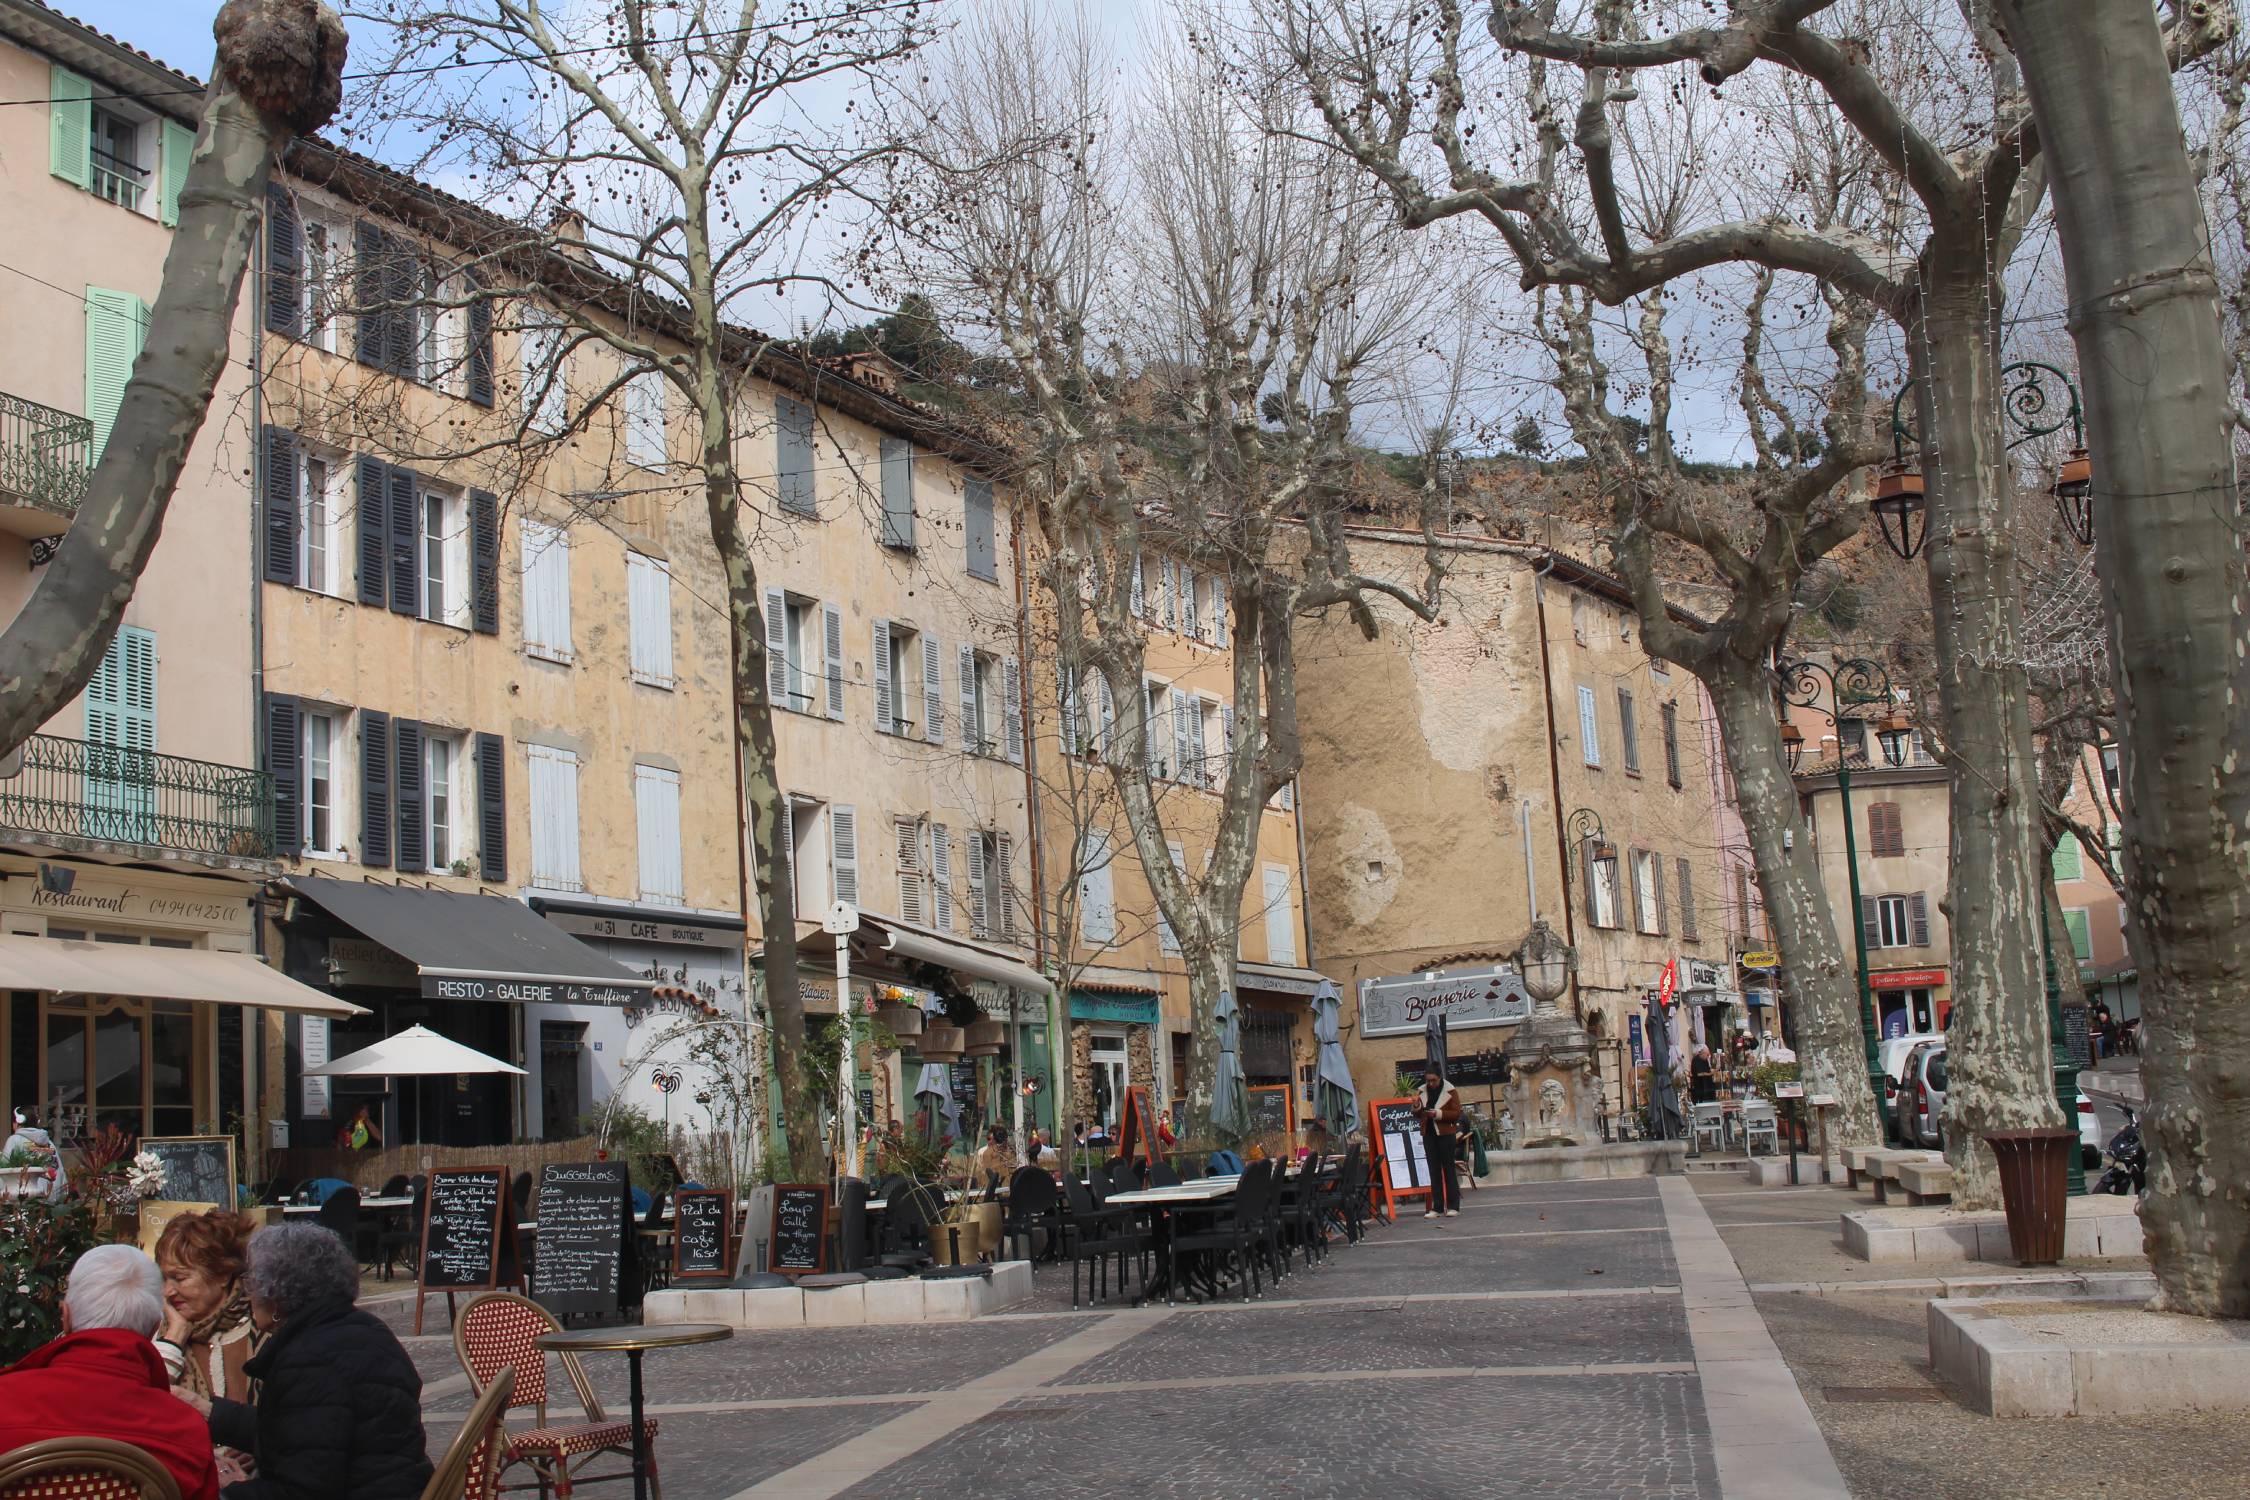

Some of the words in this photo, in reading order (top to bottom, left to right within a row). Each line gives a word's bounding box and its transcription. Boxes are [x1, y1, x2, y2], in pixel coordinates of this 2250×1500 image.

[32, 881, 140, 913] Restaurant
[605, 921, 616, 936] 31
[631, 923, 658, 940] CAFÉ
[672, 929, 705, 942] BOUTIQUE
[1662, 968, 1673, 996] TABAC
[1693, 967, 1717, 986] GALERIE
[438, 981, 485, 998] RESTO
[497, 984, 553, 1002] GALERIE
[798, 982, 832, 1000] Glacier
[1405, 984, 1480, 1022] Brasserie
